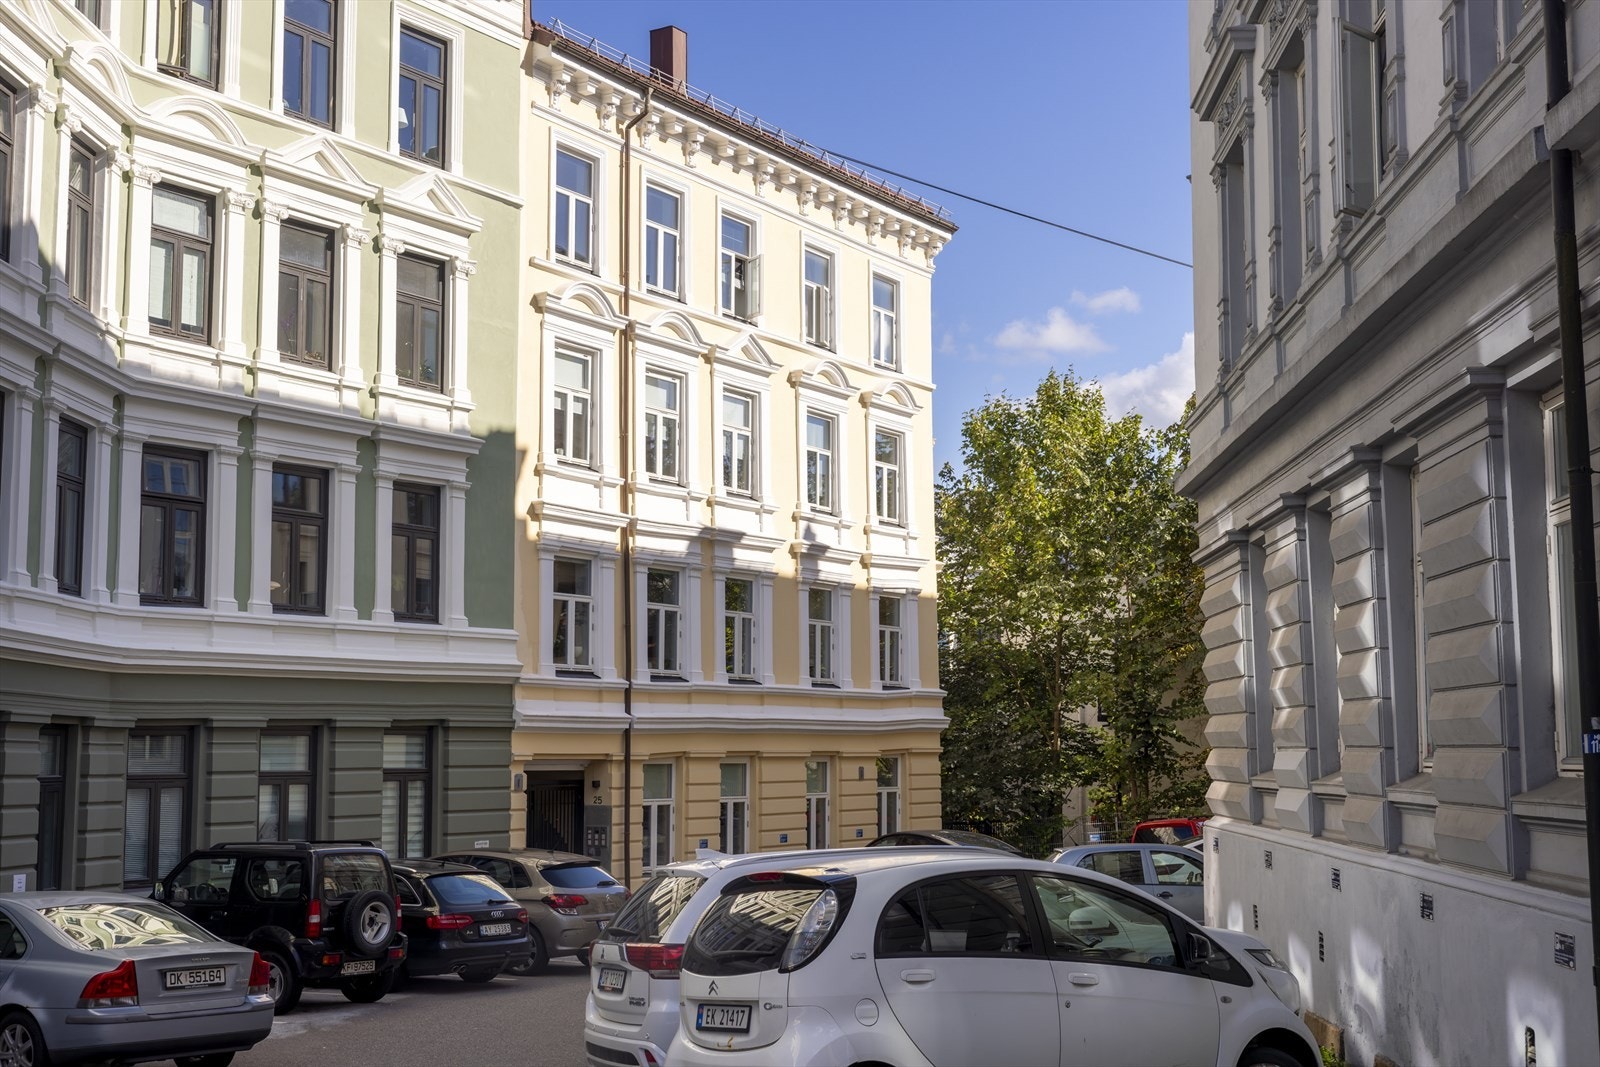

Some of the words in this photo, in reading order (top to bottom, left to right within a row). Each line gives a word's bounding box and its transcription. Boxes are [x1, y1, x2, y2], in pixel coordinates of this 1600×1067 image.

[593, 796, 603, 804] 25
[169, 972, 183, 985] DK
[188, 969, 221, 984] 55164
[705, 1008, 717, 1025] EK
[719, 1008, 746, 1027] 21417
